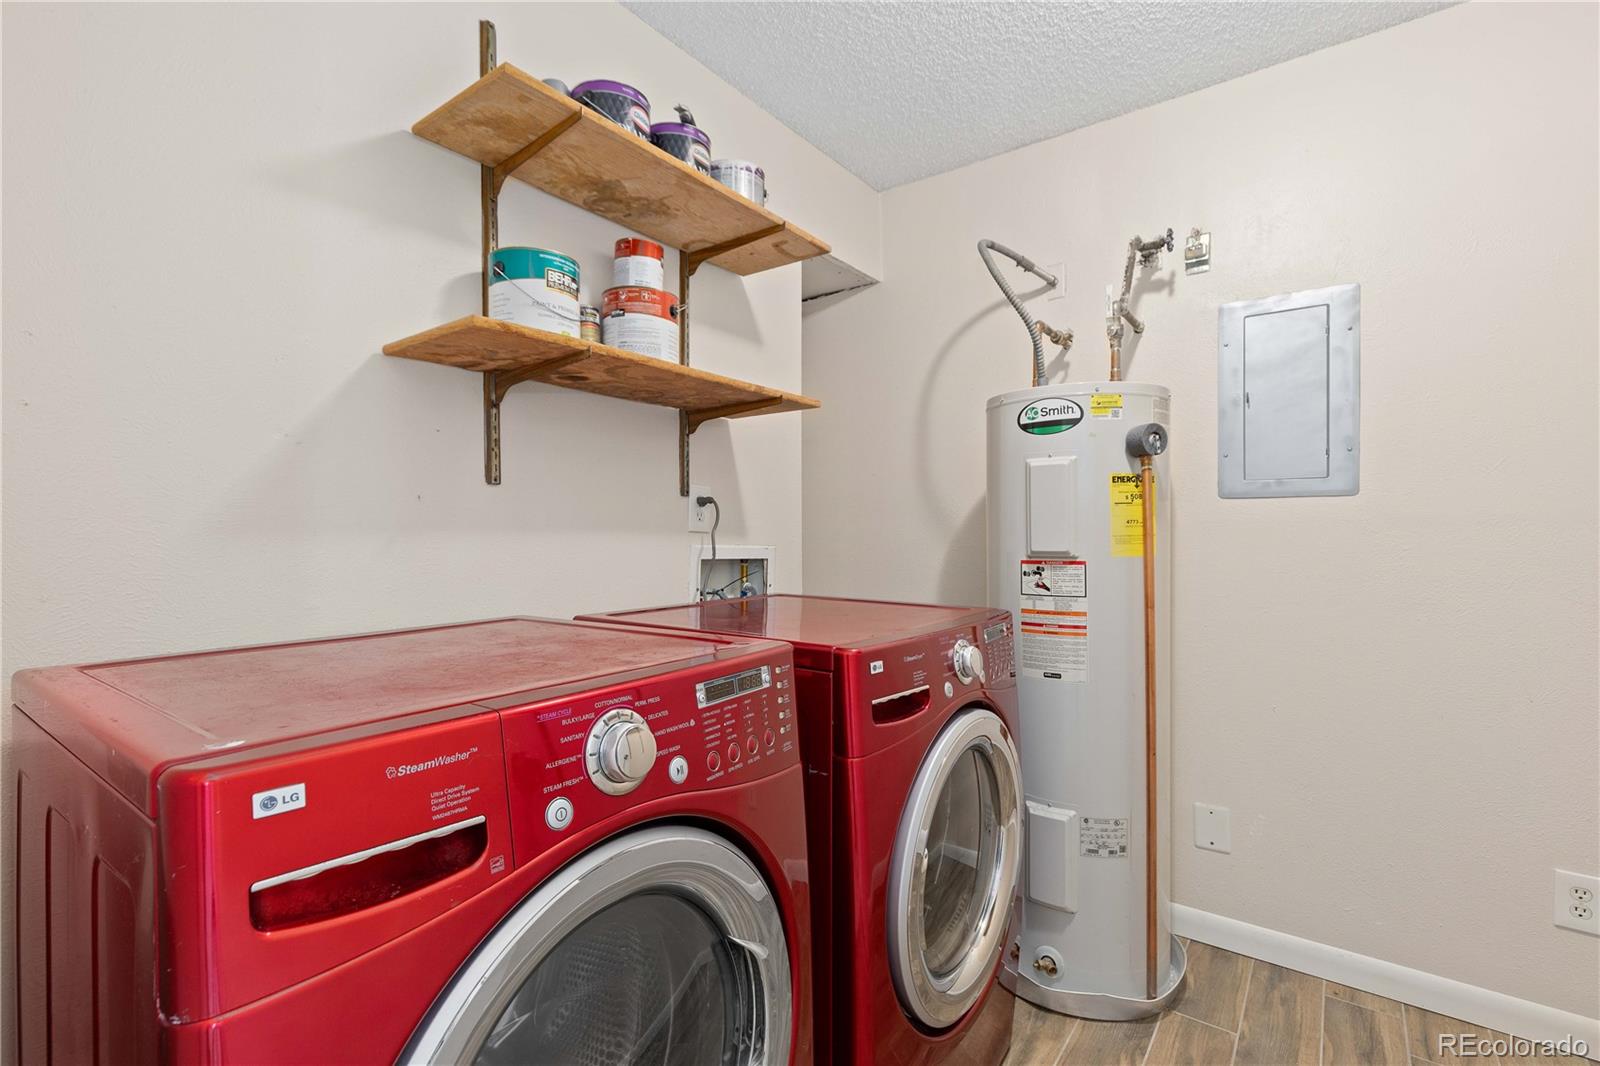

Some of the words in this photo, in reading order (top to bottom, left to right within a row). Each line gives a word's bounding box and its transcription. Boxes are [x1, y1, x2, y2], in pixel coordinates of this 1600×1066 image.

[548, 270, 573, 287] BEHR
[1040, 404, 1075, 417] Smith
[560, 732, 585, 743] SANITARY
[444, 785, 466, 795] Capacity
[543, 783, 562, 794] STEAM
[282, 792, 300, 804] LG
[447, 796, 472, 806] Operation
